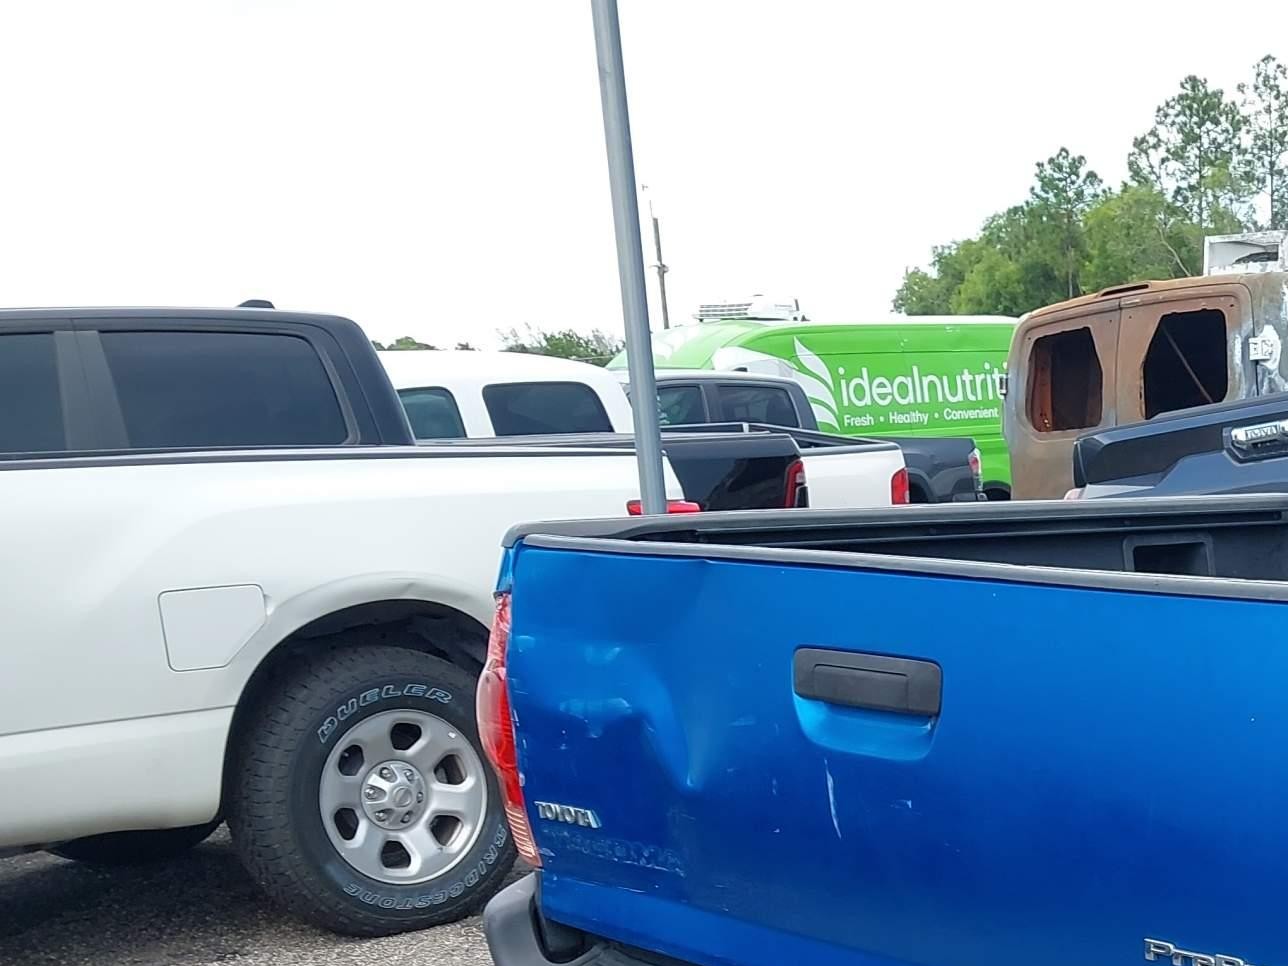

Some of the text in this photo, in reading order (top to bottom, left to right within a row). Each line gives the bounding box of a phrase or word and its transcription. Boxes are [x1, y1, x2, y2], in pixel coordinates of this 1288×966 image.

[838, 361, 1007, 407] idealnutrit
[844, 407, 999, 427] Fresh Healthy Convenient
[317, 684, 452, 744] DUELER
[534, 801, 602, 828] TOYOTA
